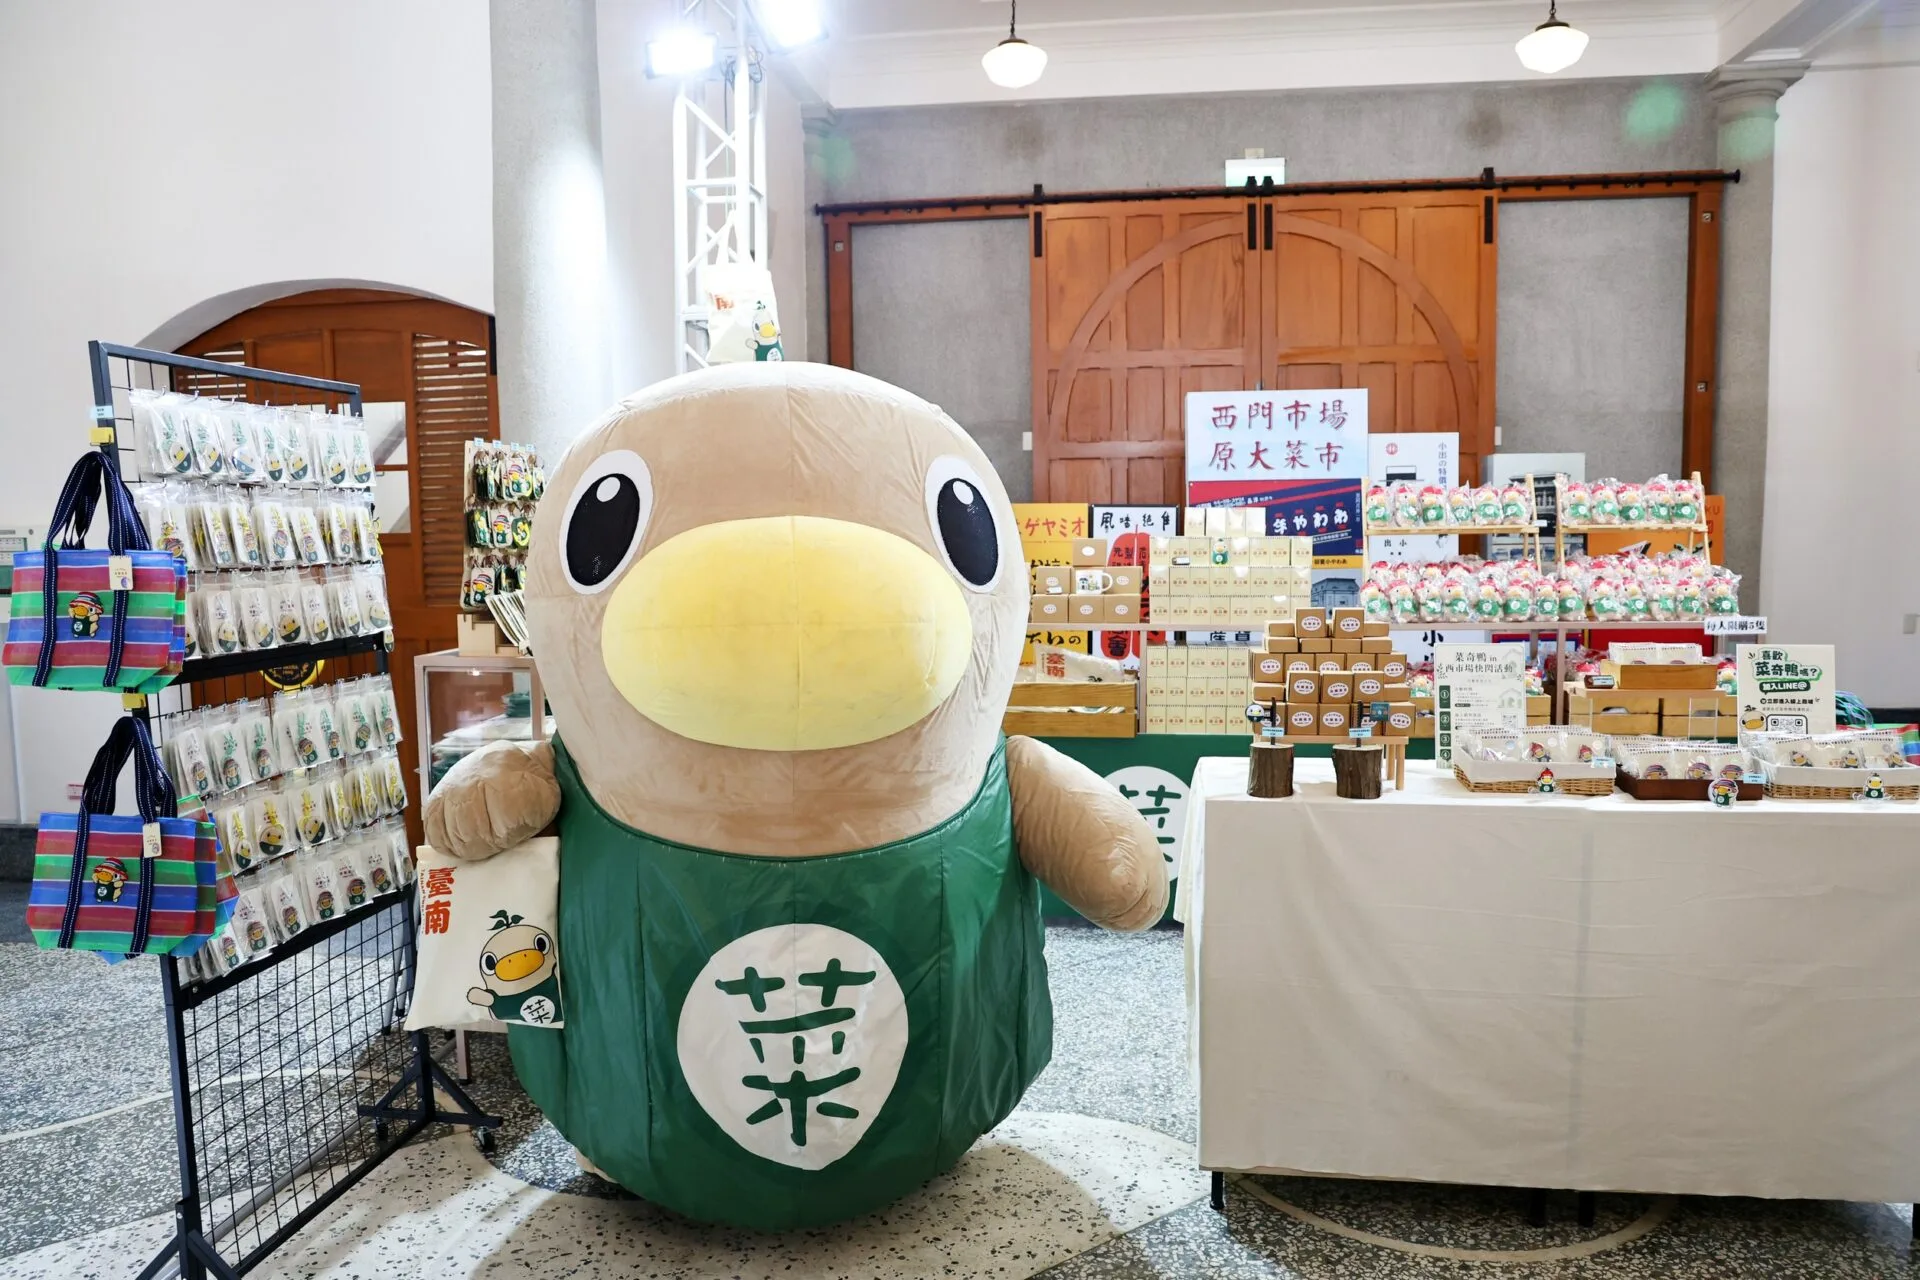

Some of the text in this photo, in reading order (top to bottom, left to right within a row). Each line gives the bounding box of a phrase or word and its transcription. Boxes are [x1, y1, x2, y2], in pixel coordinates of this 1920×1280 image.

[1211, 399, 1349, 430] 西門市場
[1208, 440, 1344, 472] 原大菜市
[1455, 652, 1487, 662] 菜奇鴨
[1762, 650, 1783, 661] 喜歡
[1445, 663, 1513, 673] 西市場快閃活動
[1762, 681, 1808, 691] 加入LINE@
[425, 866, 457, 935] 臺南
[715, 958, 877, 1147] 菜
